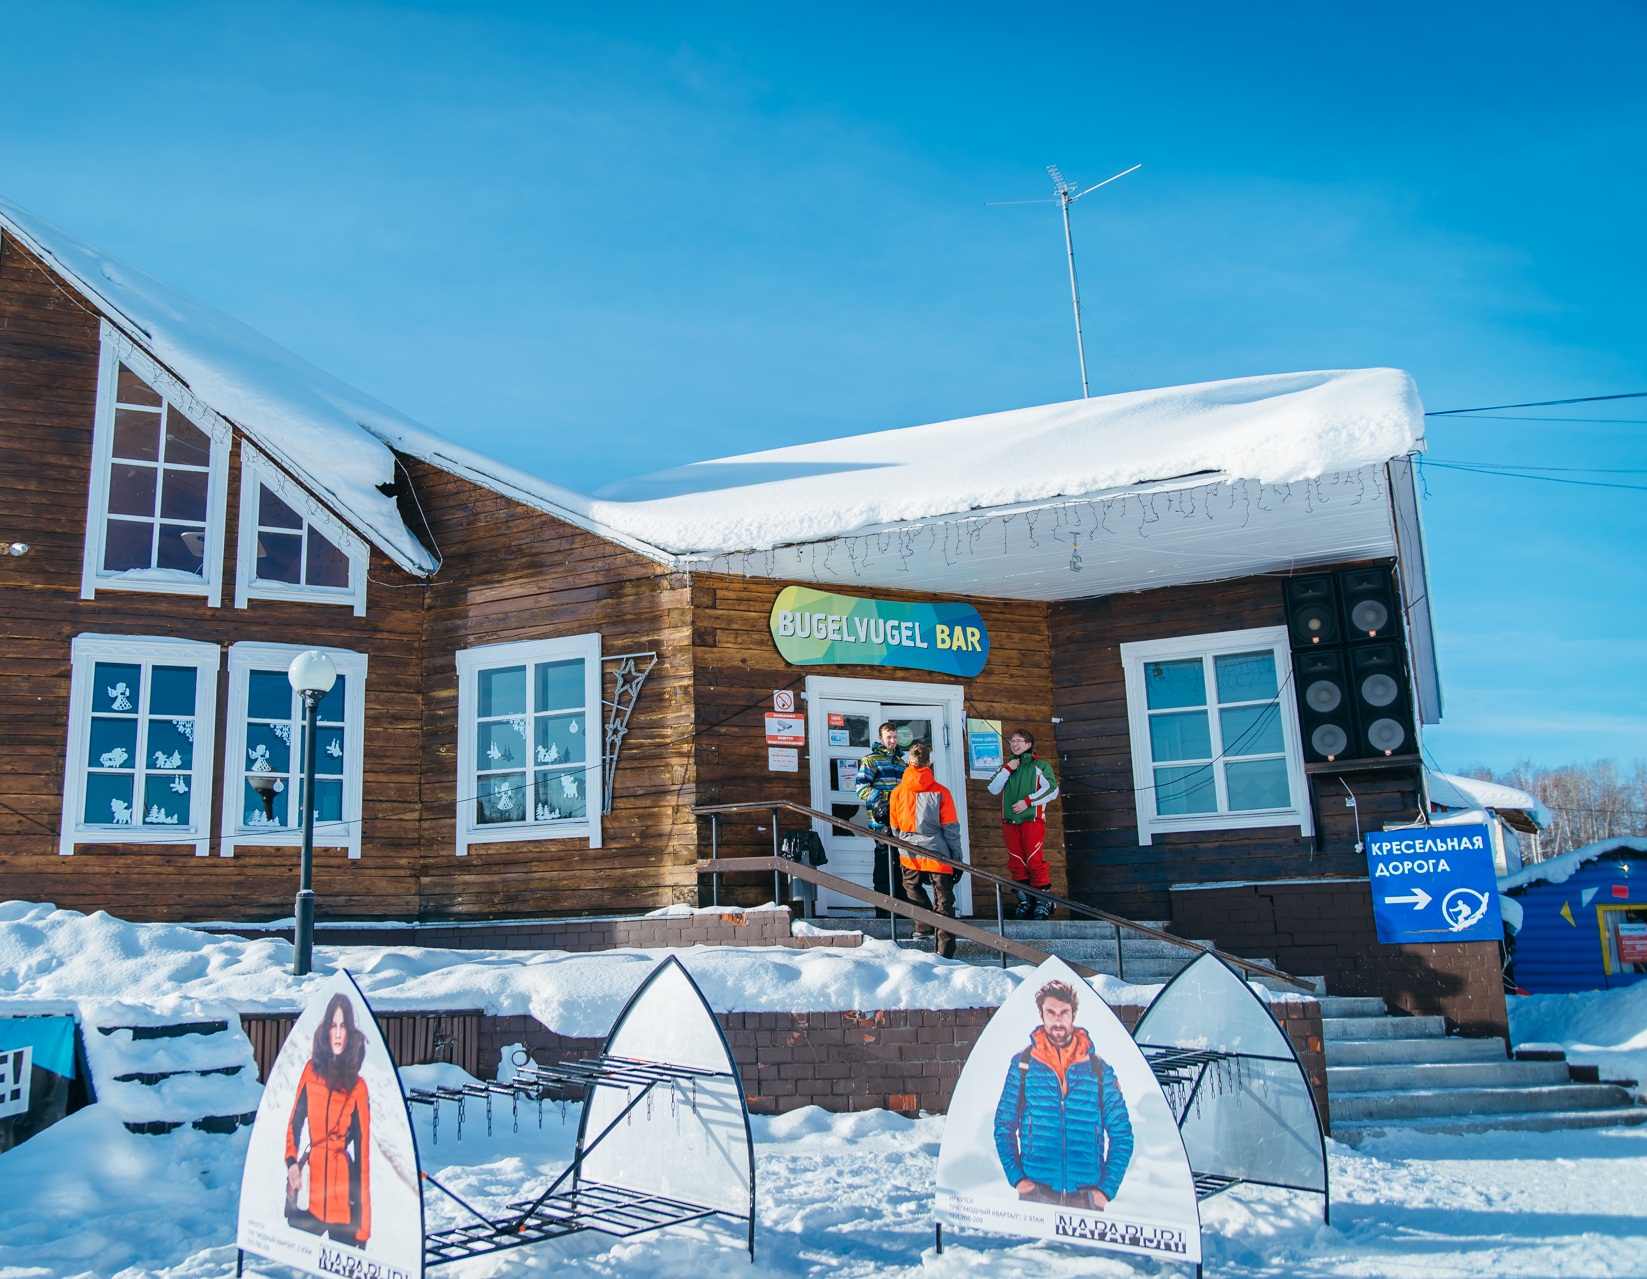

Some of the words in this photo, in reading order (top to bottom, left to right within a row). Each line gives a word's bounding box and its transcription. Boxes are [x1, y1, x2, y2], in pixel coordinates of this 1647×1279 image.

[779, 610, 928, 648] BUGELVUGEL
[936, 624, 982, 652] BAR
[1371, 836, 1483, 856] КРЕСЕЛЬНАЯ
[1375, 859, 1450, 877] ДОРОГА
[1058, 1214, 1184, 1252] NAPAPIJRI
